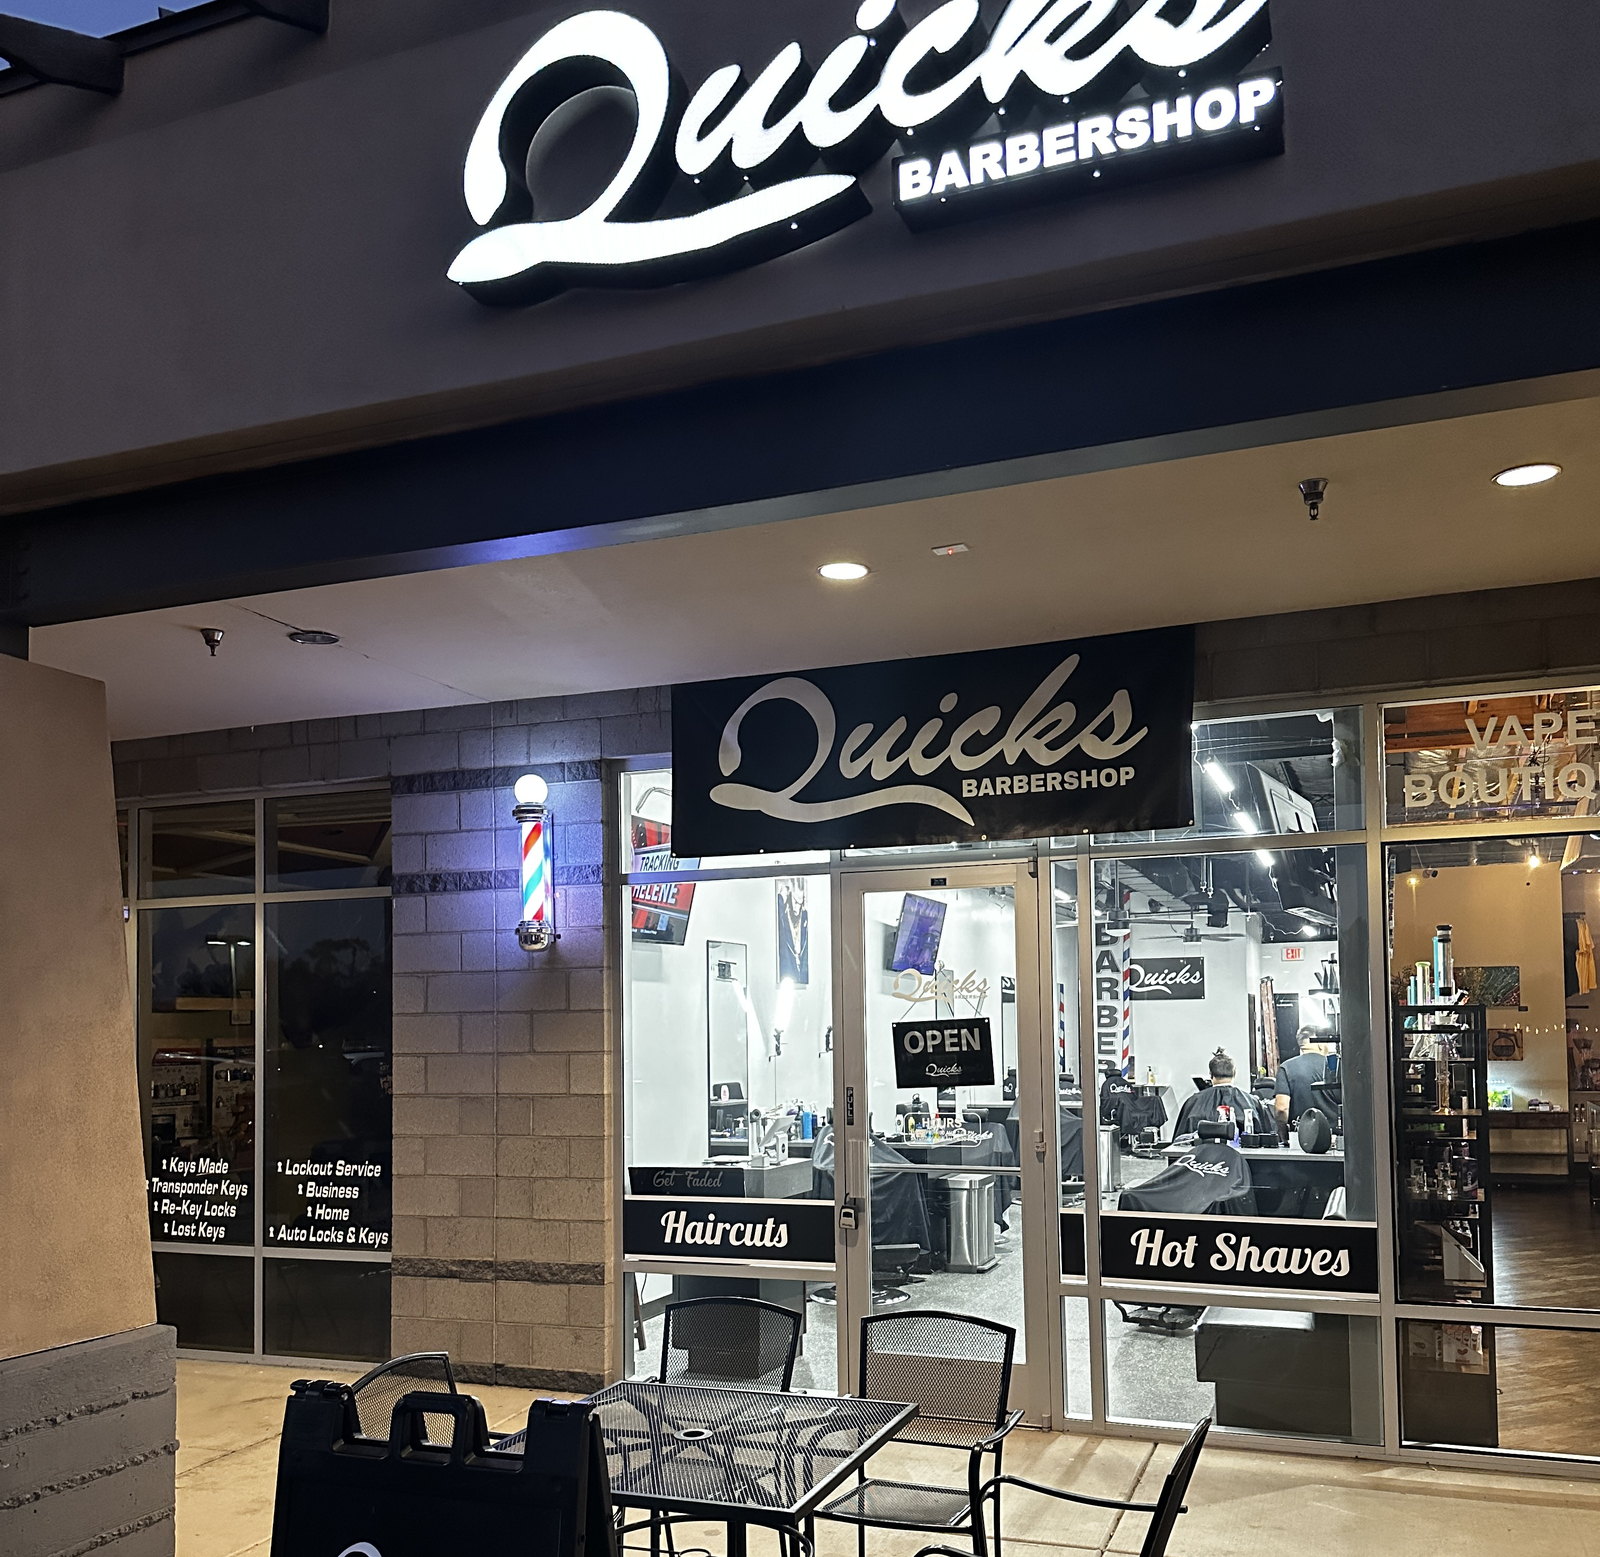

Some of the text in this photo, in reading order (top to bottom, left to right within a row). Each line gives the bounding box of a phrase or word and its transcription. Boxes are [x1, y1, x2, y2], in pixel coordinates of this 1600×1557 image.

[898, 78, 1277, 203] BARBERSHOP
[709, 653, 1149, 827] Quicks
[1465, 708, 1598, 751] VAPE
[962, 766, 1136, 798] BARBERSHOP
[1404, 761, 1600, 808] BOUTIQ
[640, 854, 680, 872] TRACKING
[1285, 948, 1301, 960] EXIT
[1130, 964, 1203, 995] Quicks
[903, 1027, 981, 1055] OPEN
[925, 1063, 962, 1077] Quicks
[169, 1157, 229, 1175] Keys Made
[285, 1160, 381, 1177] Lockout Service
[1174, 1154, 1230, 1178] Quicks
[152, 1178, 248, 1198] Transponder Keys
[653, 1170, 723, 1188] Get Faded
[305, 1182, 359, 1199] Business
[161, 1199, 237, 1219] Re-Key Locks
[315, 1204, 350, 1220] Home
[171, 1220, 226, 1239] Lost Keys
[277, 1225, 389, 1248] Auto Locks & Keys
[660, 1210, 789, 1248] Haircuts
[1130, 1228, 1351, 1277] Hot Shaves
